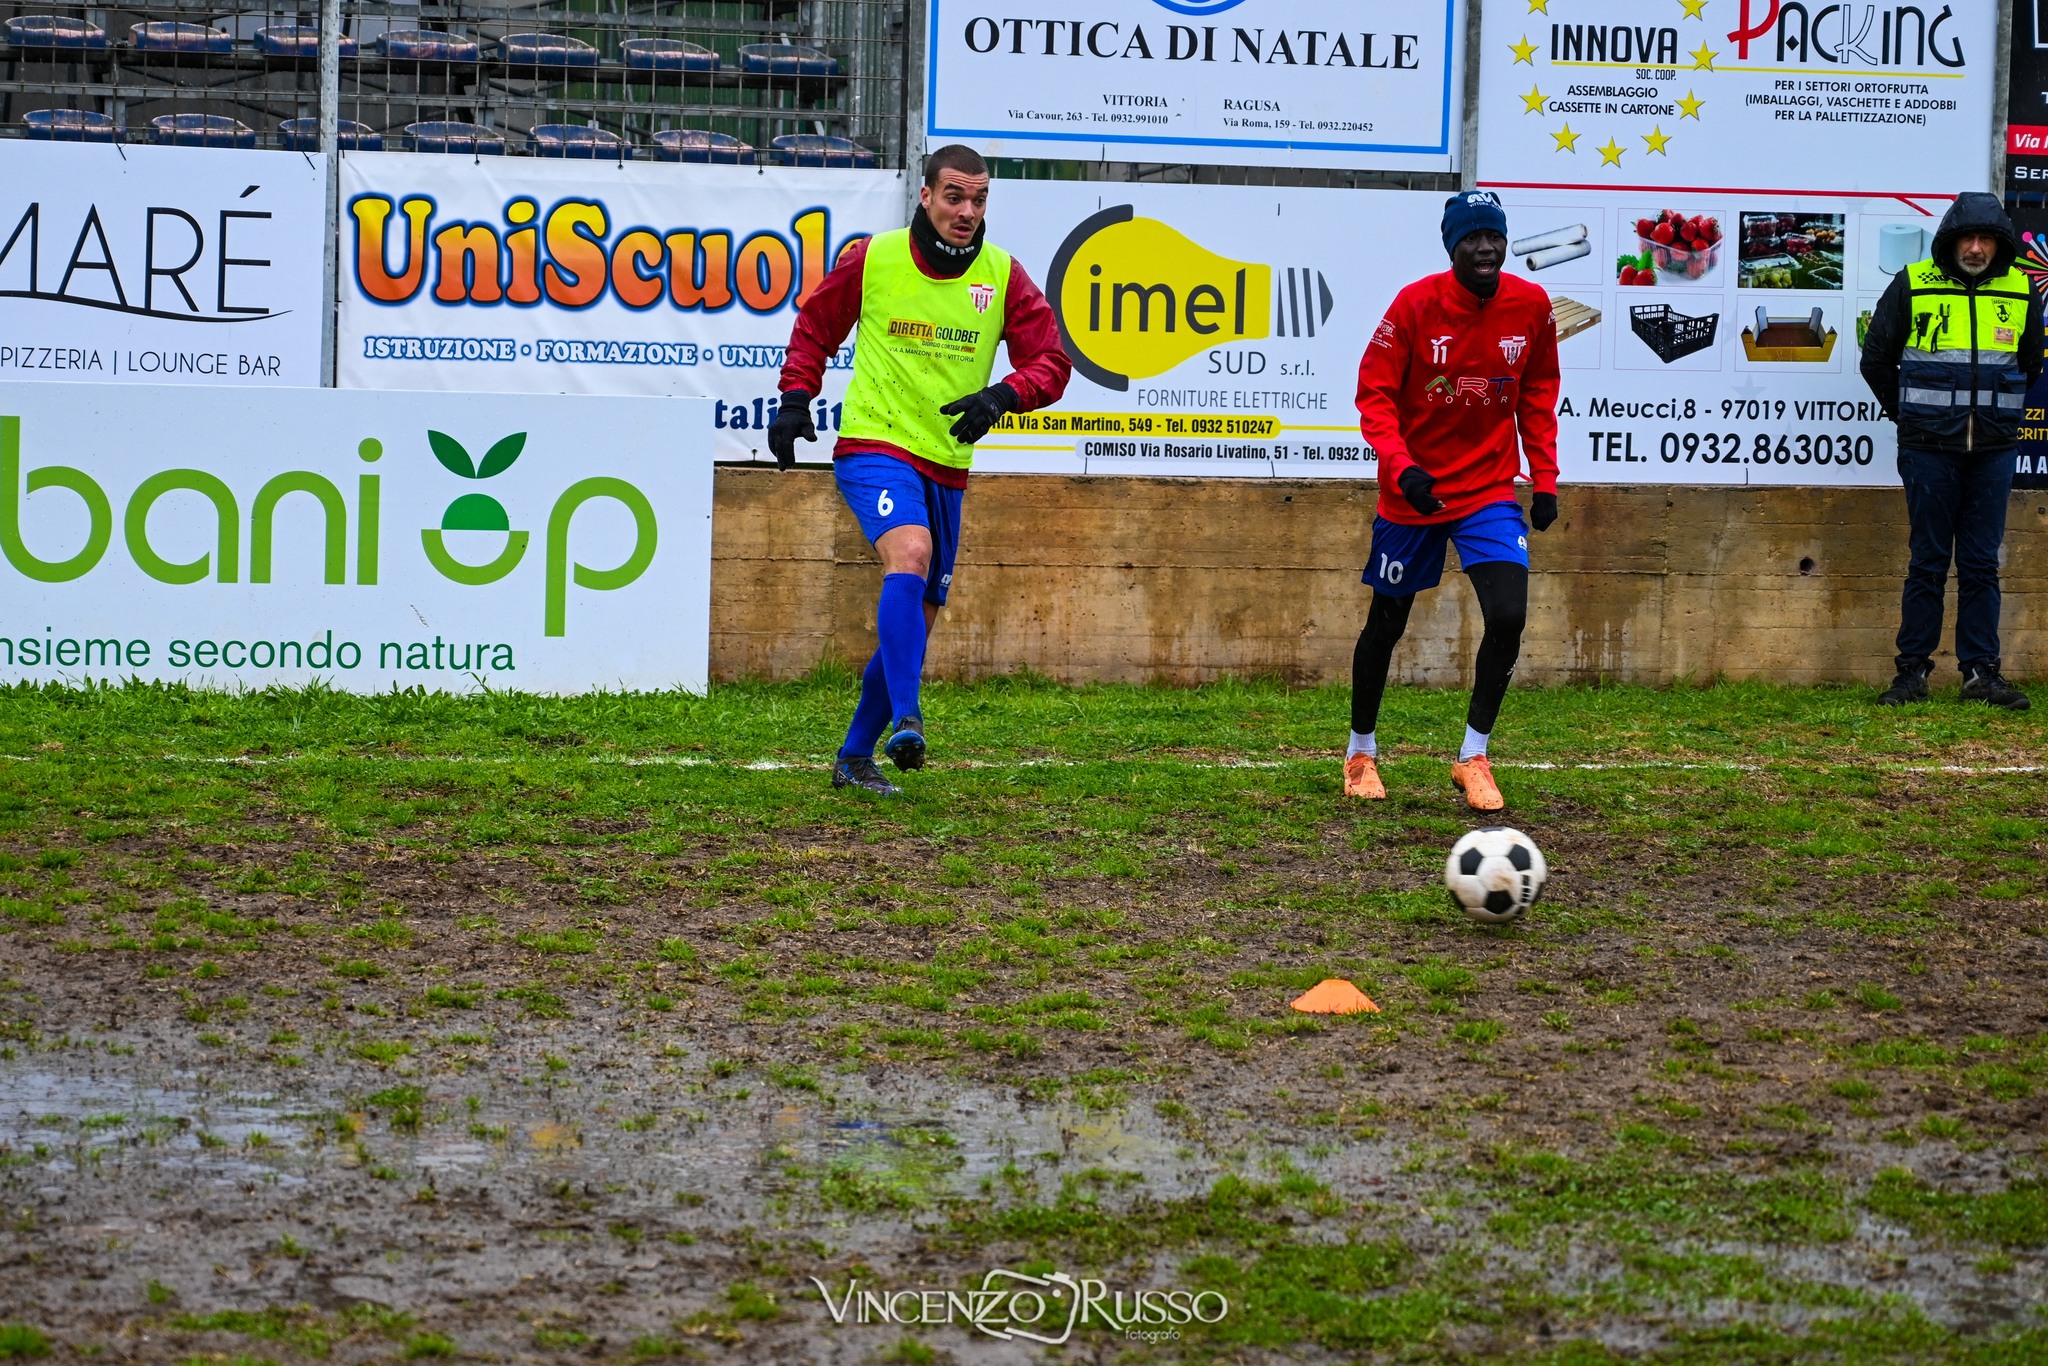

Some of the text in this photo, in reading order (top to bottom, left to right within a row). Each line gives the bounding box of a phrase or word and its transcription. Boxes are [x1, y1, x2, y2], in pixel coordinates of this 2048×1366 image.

[964, 16, 1420, 70] OTTICA DI NATALE
[1551, 24, 1678, 64] INNOVA
[1636, 69, 1677, 81] SOC. COOP.
[1567, 85, 1658, 98] ASSEMBLAGGIO
[1775, 80, 1929, 95] PER I SETTORI ORTOFRUTTA
[1102, 94, 1168, 108] VITTORIA
[1223, 98, 1281, 112] RAGUSA
[1549, 101, 1674, 116] CASSETTE IN CARTONE
[1745, 94, 1957, 110] (IMBALLAGGI, VASCHETTE E ADDOBBI
[1008, 109, 1024, 120] Via
[1026, 110, 1064, 122] Cavour,
[1066, 112, 1083, 121] 263
[1091, 112, 1108, 123] Tel.
[1110, 113, 1168, 125] 0932.991010
[1223, 117, 1239, 128] Via
[1241, 118, 1272, 130] Roma,
[1274, 119, 1290, 129] 159
[1298, 120, 1315, 130] Tel.
[1317, 120, 1373, 132] 0932.220452
[1775, 110, 1927, 126] PER LA PALLETTIZZAZIONE)
[2015, 133, 2040, 148] Via
[348, 191, 873, 315] UniScuol
[1089, 263, 1246, 335] imel
[890, 321, 980, 344] DIRETTA GOLDBET
[364, 336, 516, 361] ISTRUZIONE
[536, 340, 698, 365] FORMAZIONE
[947, 353, 975, 363] VITTORIA
[1432, 345, 1447, 364] 11
[1, 346, 103, 370] PIZZERIA
[128, 351, 228, 375] LOUNGE
[238, 354, 281, 377] BAR
[1208, 350, 1315, 376] SUD s.r.l.
[1137, 388, 1328, 410] FORNITURE ELETTRICHE
[1557, 397, 1581, 418] A.
[1588, 397, 1697, 422] Meucci,8
[1720, 399, 1787, 421] 97019
[1018, 415, 1038, 430] Via
[1042, 416, 1067, 431] San
[1071, 416, 1125, 433] Martino,
[1128, 418, 1152, 432] 549
[1165, 418, 1187, 433] Tel.
[1191, 419, 1222, 433] 0932
[1226, 419, 1273, 434] 510247
[1085, 441, 1136, 457] COMISO
[1140, 442, 1160, 458] Via
[1164, 443, 1213, 459] Rosario
[1216, 444, 1270, 461] Livatino,
[1274, 446, 1289, 460] 51
[1302, 446, 1324, 460] Tel.
[1328, 447, 1359, 461] 0932
[1588, 431, 1874, 466] TEL. 0932.863030
[877, 489, 894, 517] 6
[1380, 553, 1404, 584] 10
[168, 630, 362, 669] secondo
[379, 636, 516, 671] natura
